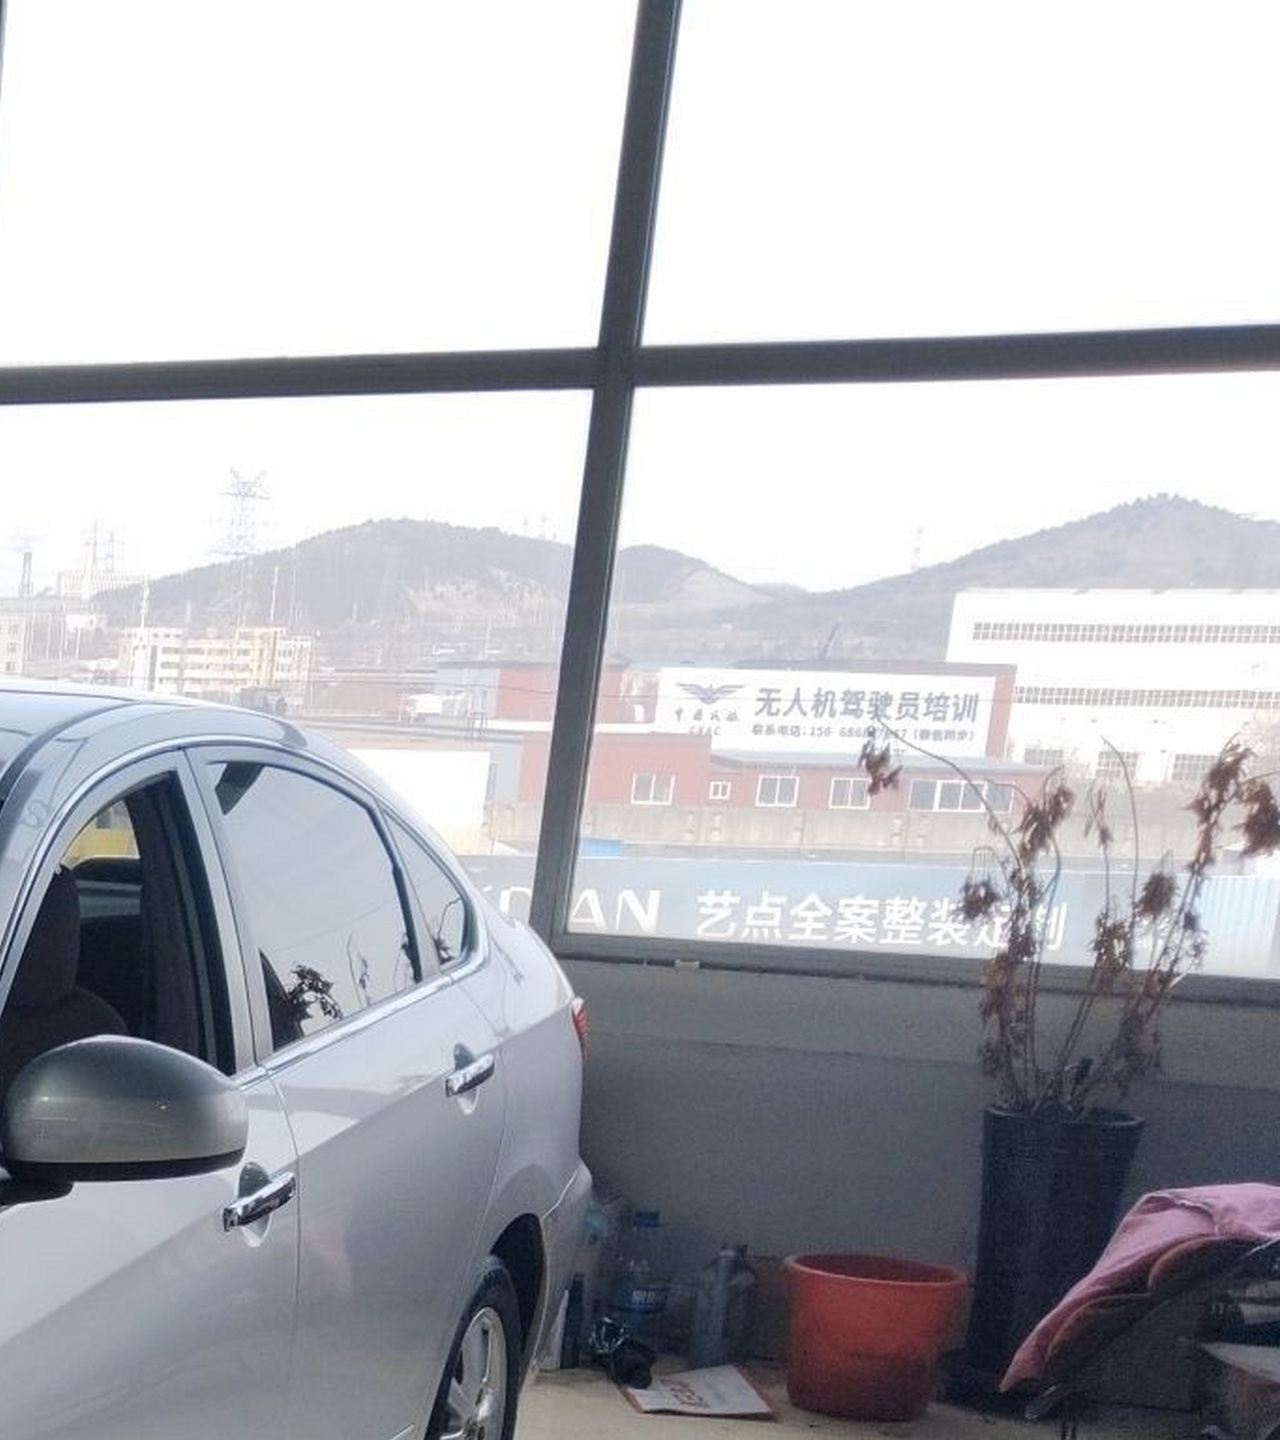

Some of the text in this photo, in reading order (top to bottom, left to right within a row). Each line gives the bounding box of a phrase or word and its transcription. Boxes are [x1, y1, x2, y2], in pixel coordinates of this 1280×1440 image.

[754, 685, 980, 723] 无人机驾驶员培训
